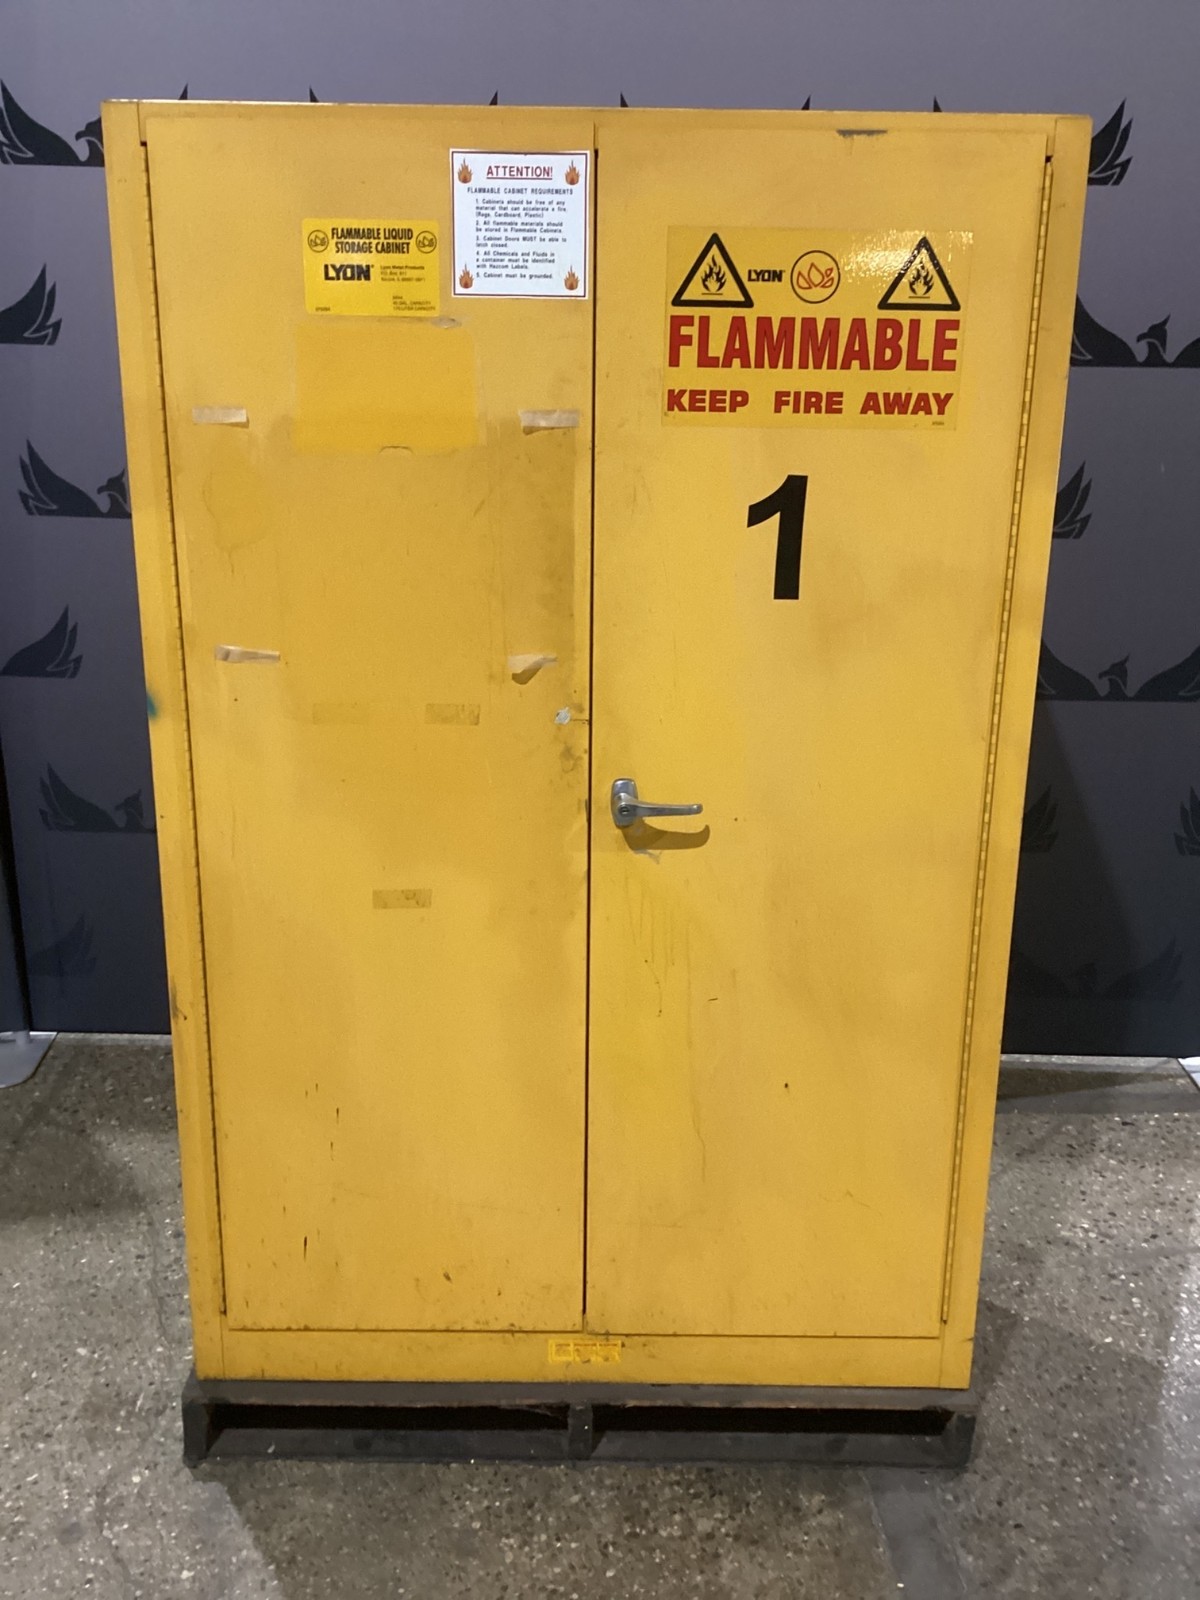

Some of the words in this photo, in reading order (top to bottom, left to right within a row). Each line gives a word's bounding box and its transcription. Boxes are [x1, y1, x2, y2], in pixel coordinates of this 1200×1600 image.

[486, 165, 553, 177] ATTENTION!
[331, 228, 381, 240] FLAMMABLE
[384, 228, 413, 240] LIQUID
[335, 242, 372, 254] STORAGE
[375, 242, 410, 254] CABINET
[324, 264, 371, 281] LYON
[748, 268, 782, 282] LYON
[668, 315, 960, 372] FLAMMABLE
[666, 388, 749, 413] KEEP
[774, 390, 844, 414] FIRE
[860, 392, 954, 415] AWAY
[746, 474, 808, 600] 1
